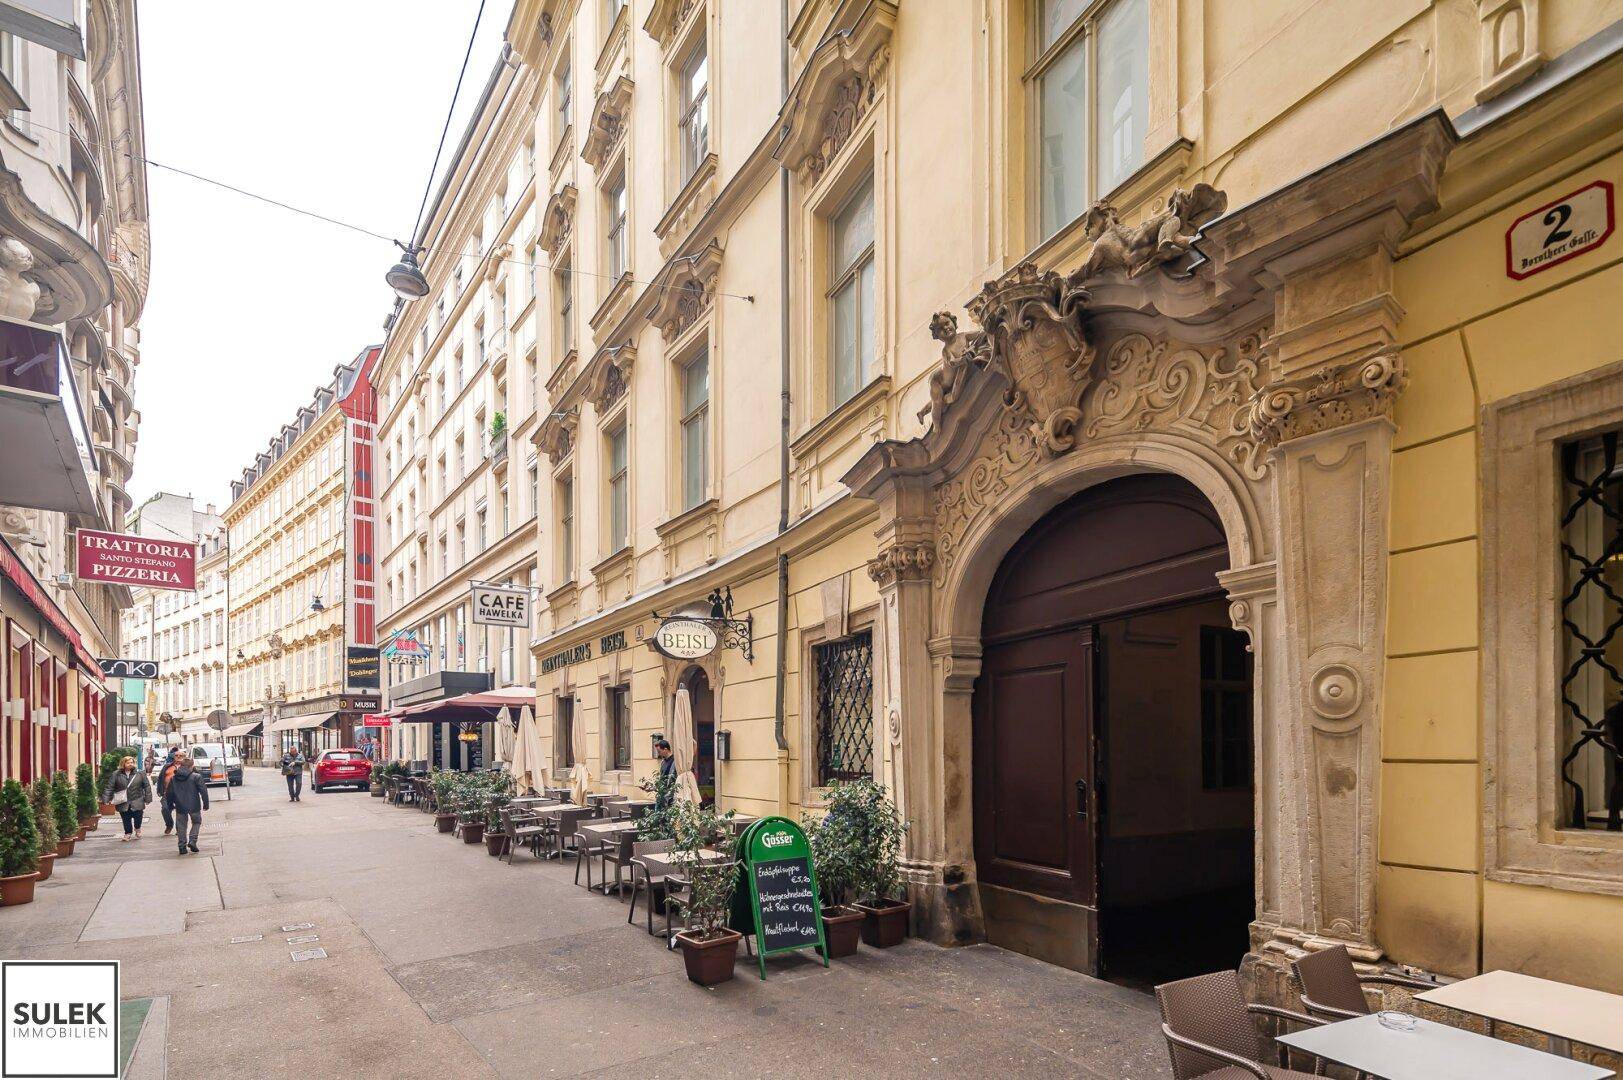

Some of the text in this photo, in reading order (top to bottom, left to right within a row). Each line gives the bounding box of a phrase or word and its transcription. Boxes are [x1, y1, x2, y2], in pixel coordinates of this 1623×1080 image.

[1543, 204, 1572, 249] 2
[82, 535, 192, 559] TRATTORIA
[100, 553, 176, 568] SANTO STEFANO
[92, 563, 182, 584] PIZZERIA
[480, 594, 524, 610] CAFÉ
[479, 608, 523, 619] HAWELKA
[600, 630, 628, 655] BEISL
[663, 633, 713, 650] BEISL
[354, 701, 376, 709] MUSIK
[762, 832, 794, 848] Gösser
